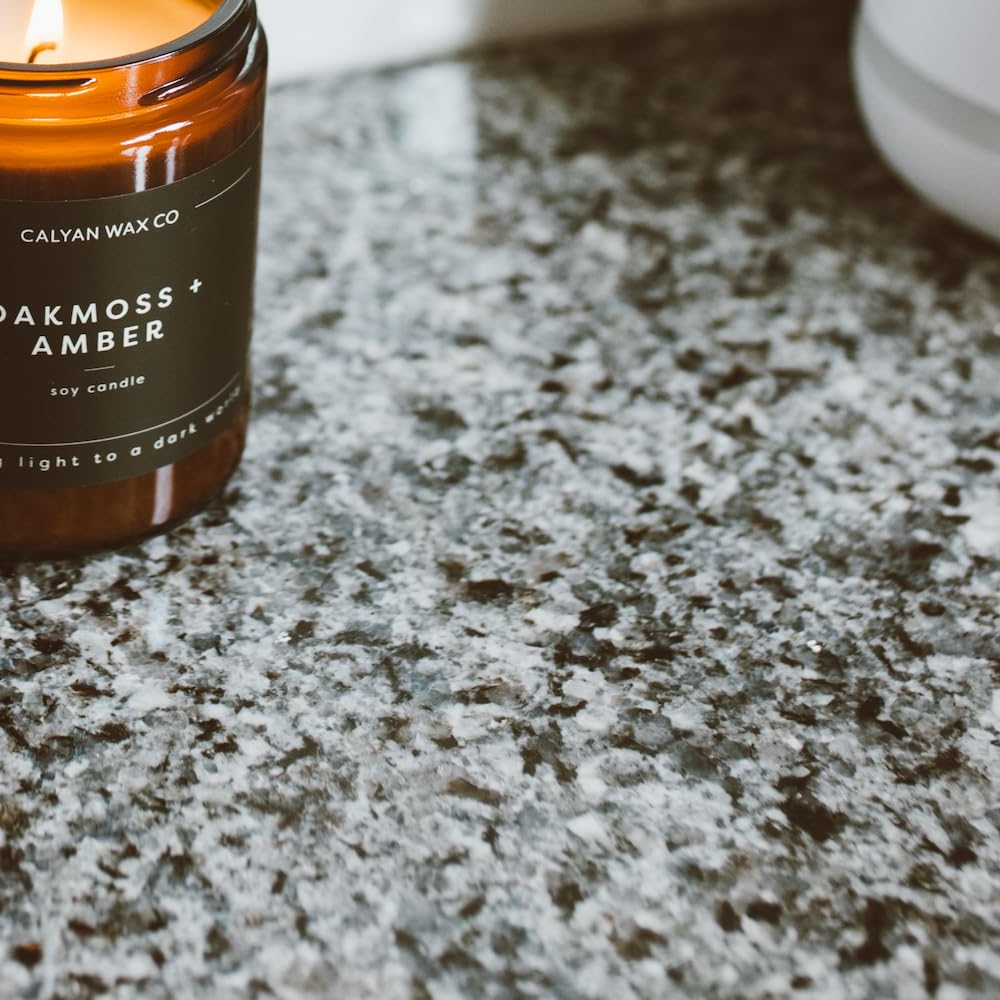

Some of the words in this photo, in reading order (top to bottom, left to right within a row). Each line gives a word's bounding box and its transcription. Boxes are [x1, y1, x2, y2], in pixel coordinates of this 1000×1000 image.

[20, 225, 100, 243] CALYAN
[104, 217, 150, 239] WAX
[152, 209, 180, 229] CO
[188, 278, 204, 295] +
[30, 319, 165, 356] AMBER
[50, 386, 80, 398] soy
[86, 375, 147, 394] candle
[18, 453, 81, 472] light
[93, 452, 119, 465] to
[129, 446, 143, 457] a
[153, 422, 199, 450] dark
